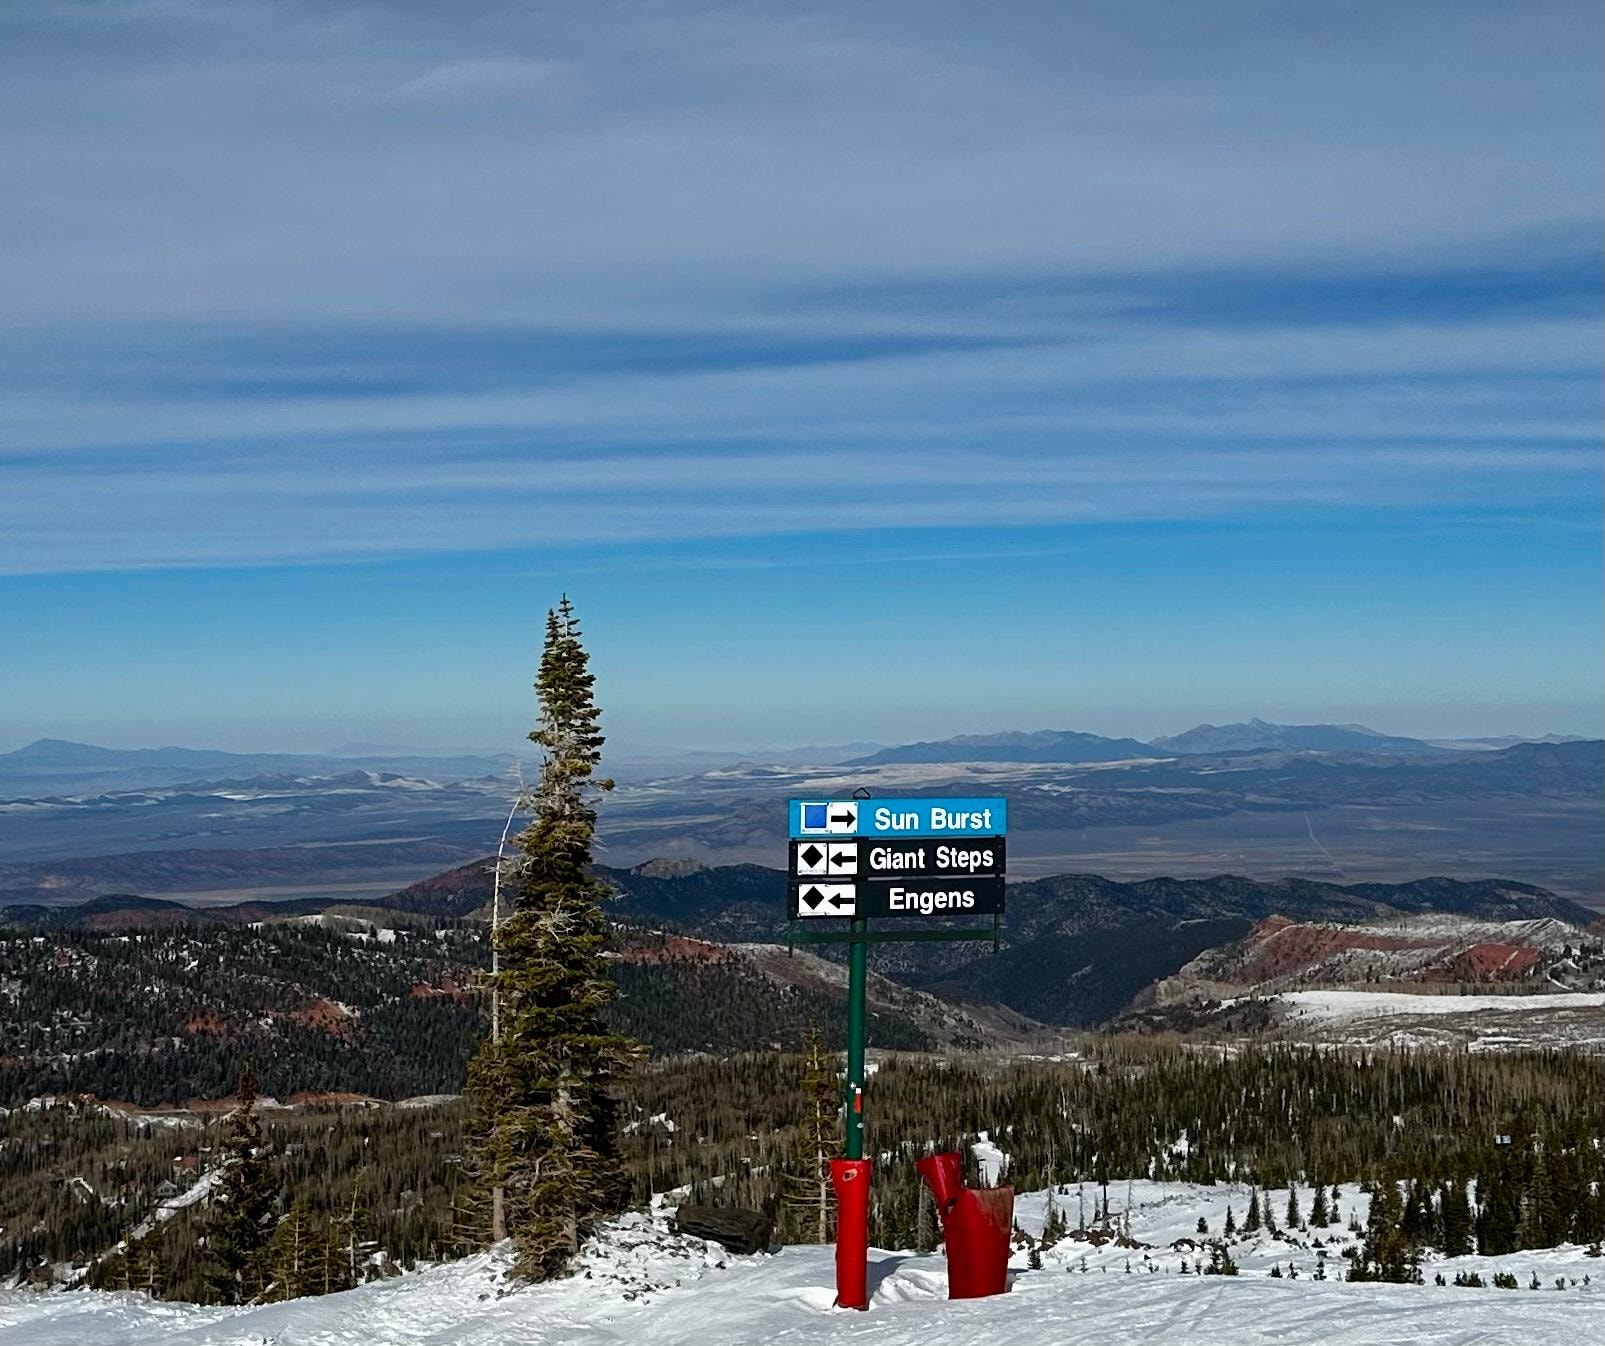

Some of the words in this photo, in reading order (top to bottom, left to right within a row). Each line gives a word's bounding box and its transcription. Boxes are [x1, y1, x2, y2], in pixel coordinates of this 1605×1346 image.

[875, 807, 919, 830] Sun
[931, 807, 992, 830] Burst
[869, 847, 926, 870] Giant
[936, 846, 994, 872] Steps
[889, 887, 975, 914] Engens
